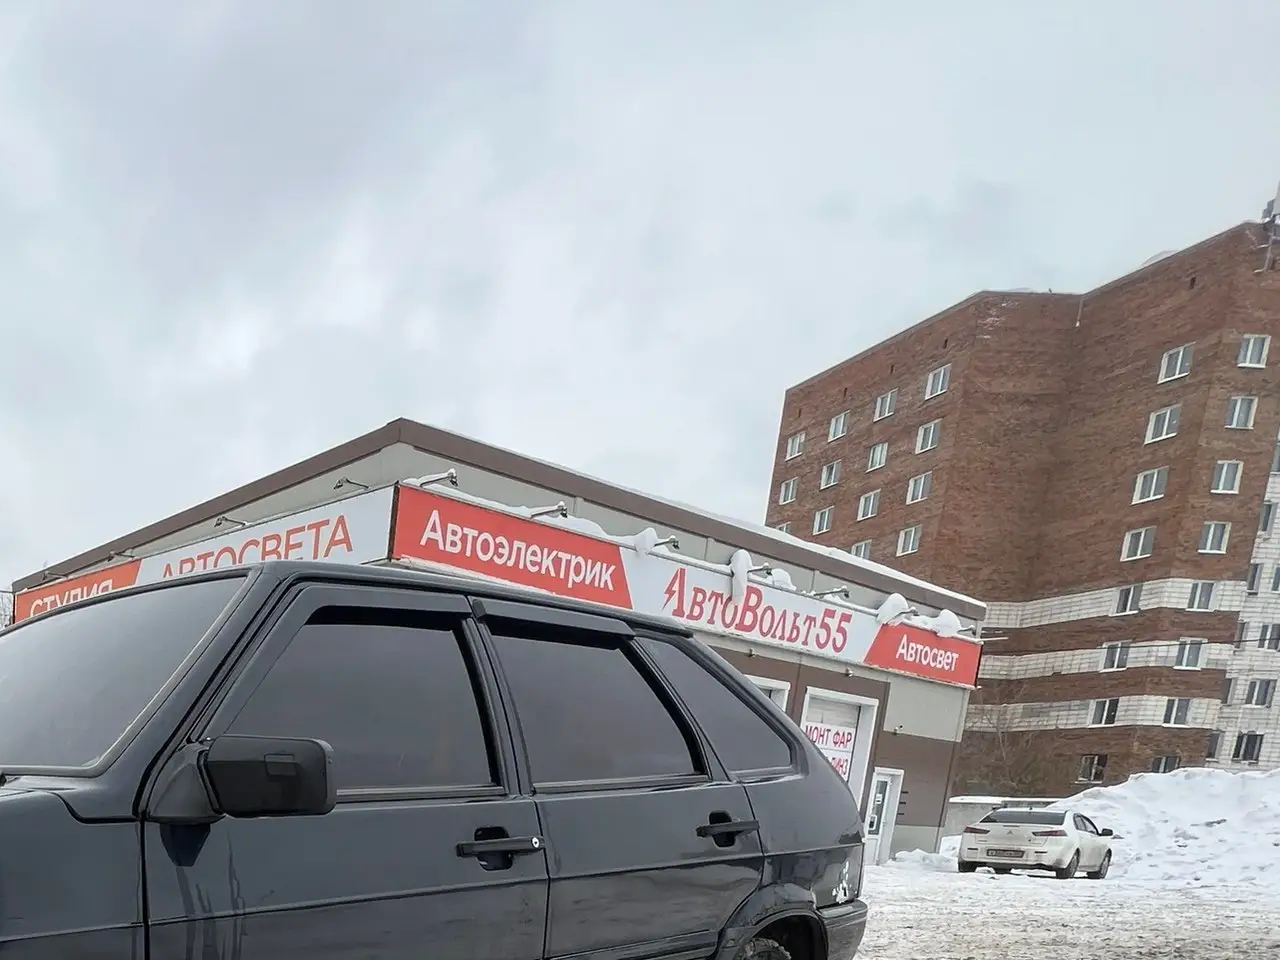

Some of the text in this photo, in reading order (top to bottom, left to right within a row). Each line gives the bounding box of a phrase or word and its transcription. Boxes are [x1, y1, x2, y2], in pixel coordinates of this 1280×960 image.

[420, 509, 616, 591] Автоэлектрик
[895, 634, 959, 672] Автосвет
[833, 730, 852, 748] ФАР
